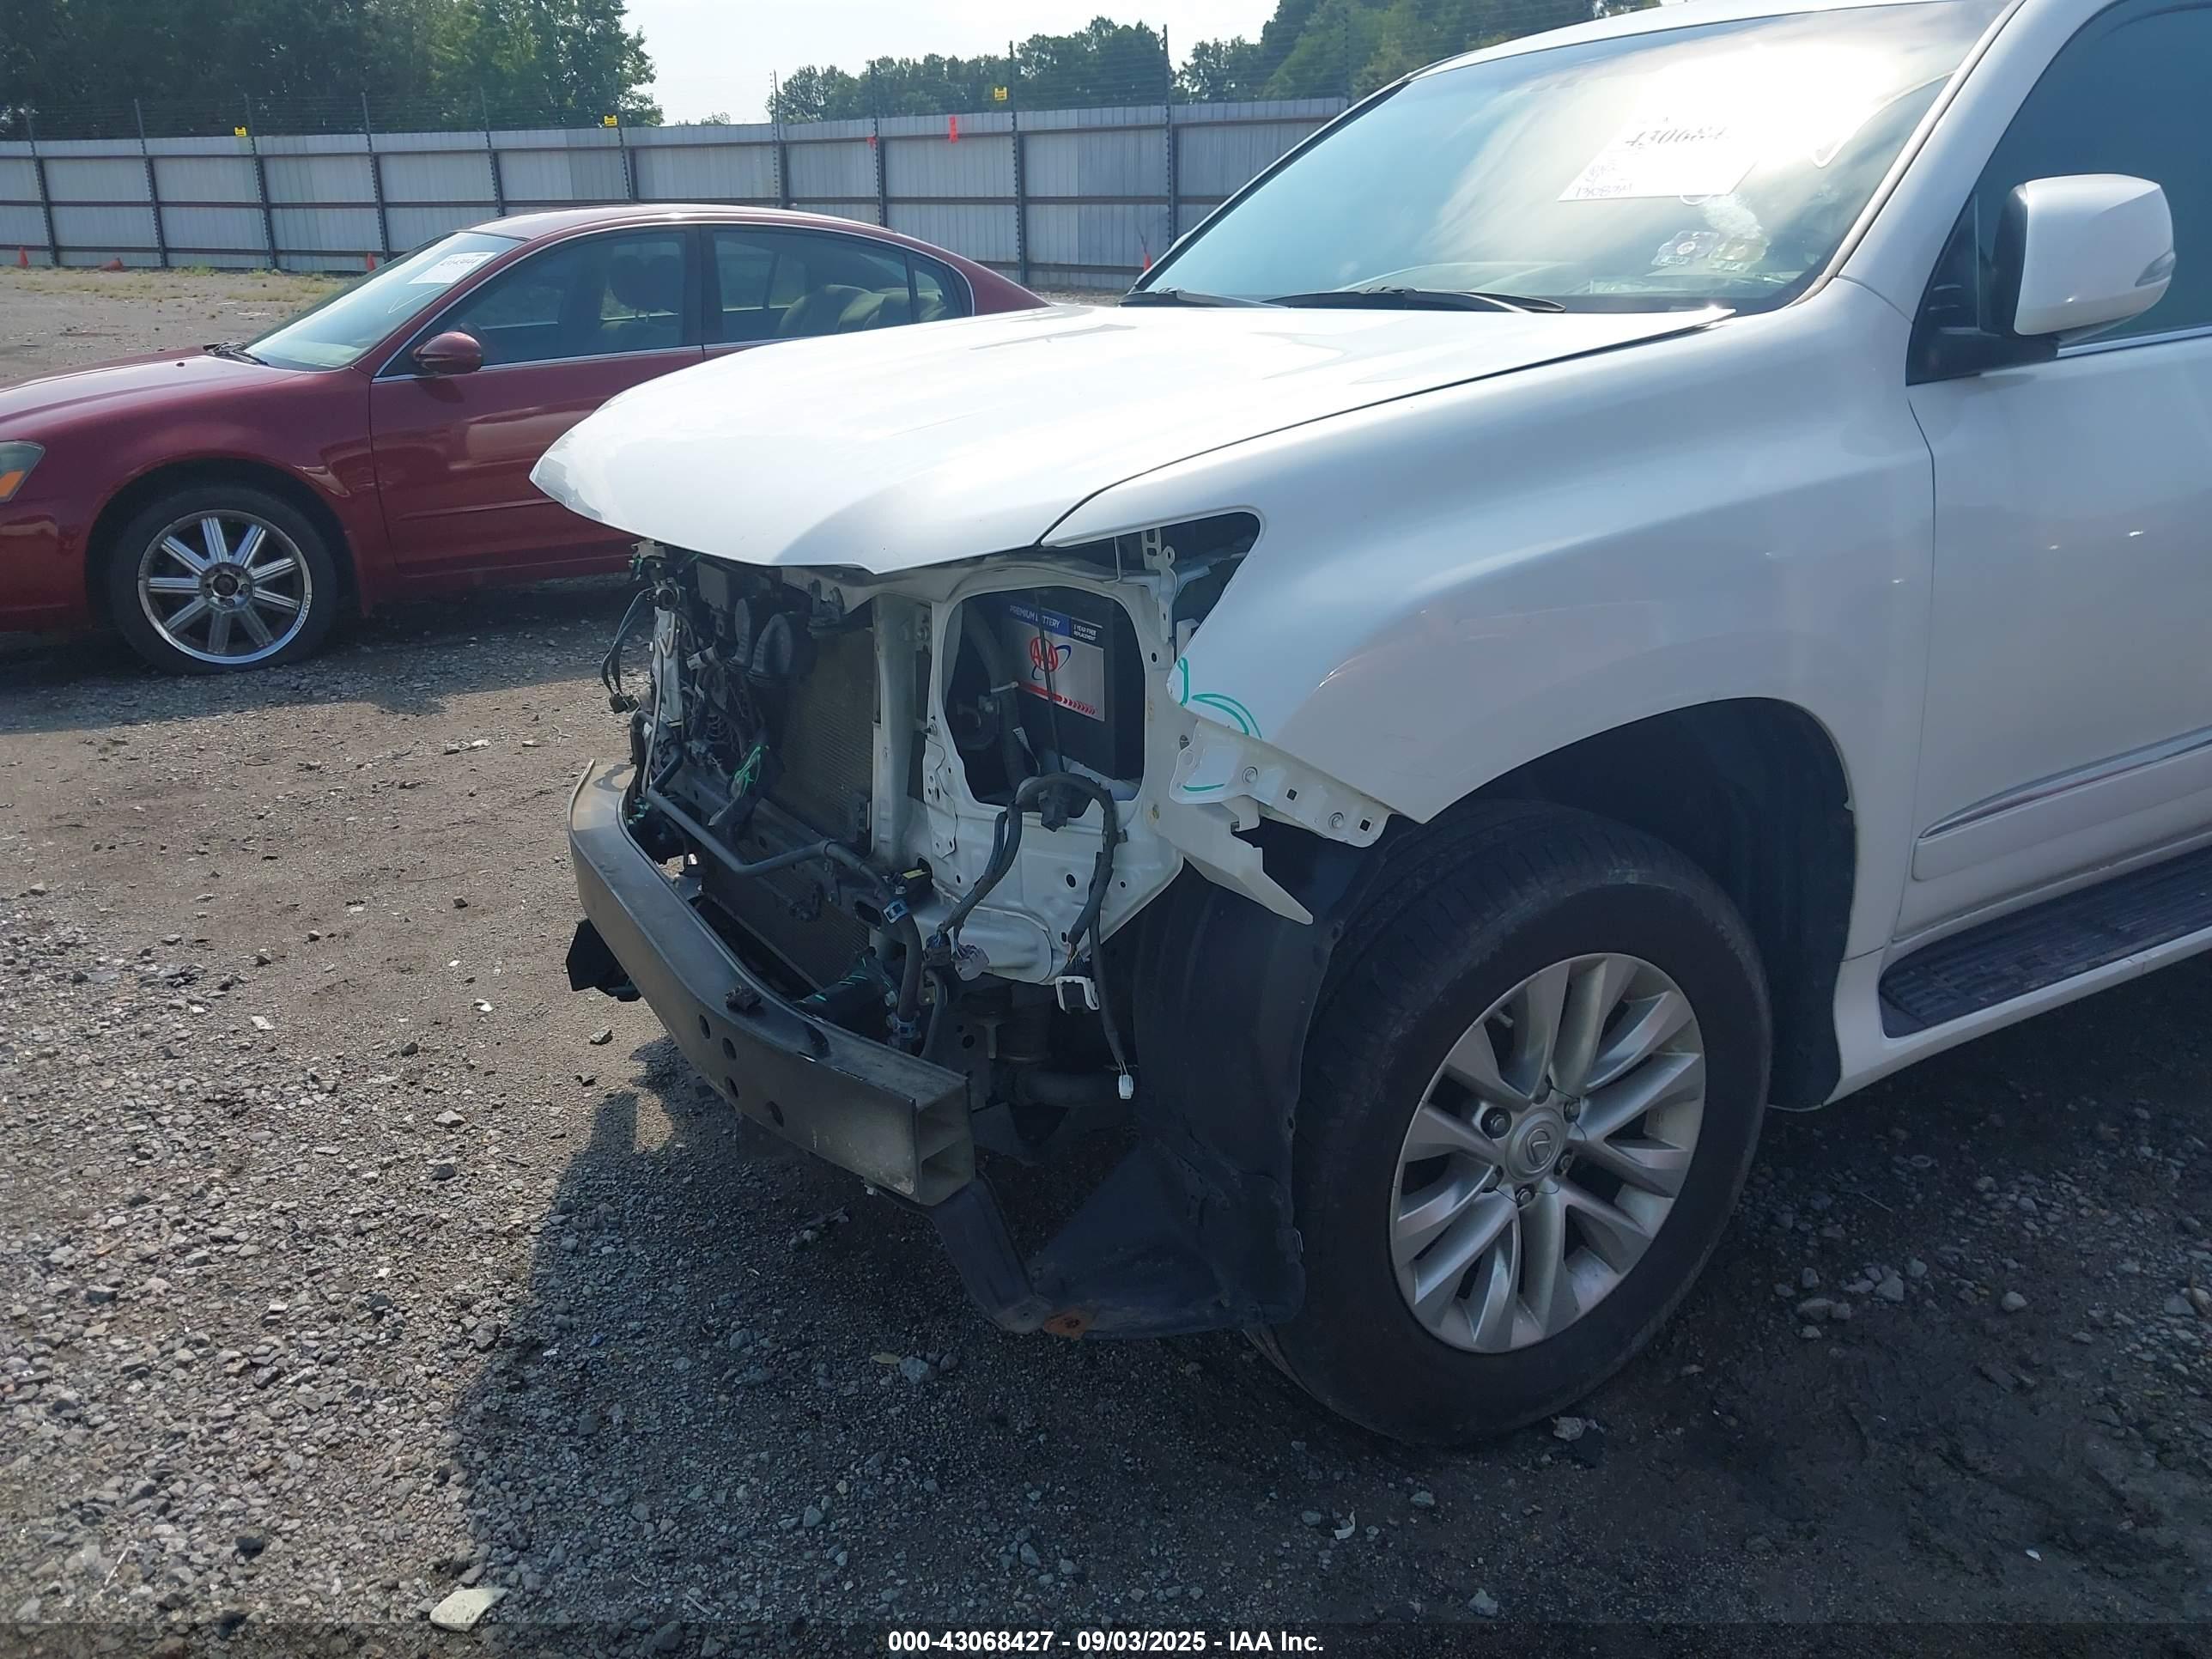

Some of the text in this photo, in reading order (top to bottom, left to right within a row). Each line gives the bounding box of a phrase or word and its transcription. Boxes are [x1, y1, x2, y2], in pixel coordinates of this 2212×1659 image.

[1009, 605, 1060, 629] PREMIUM TTERY
[1031, 637, 1058, 672] AA
